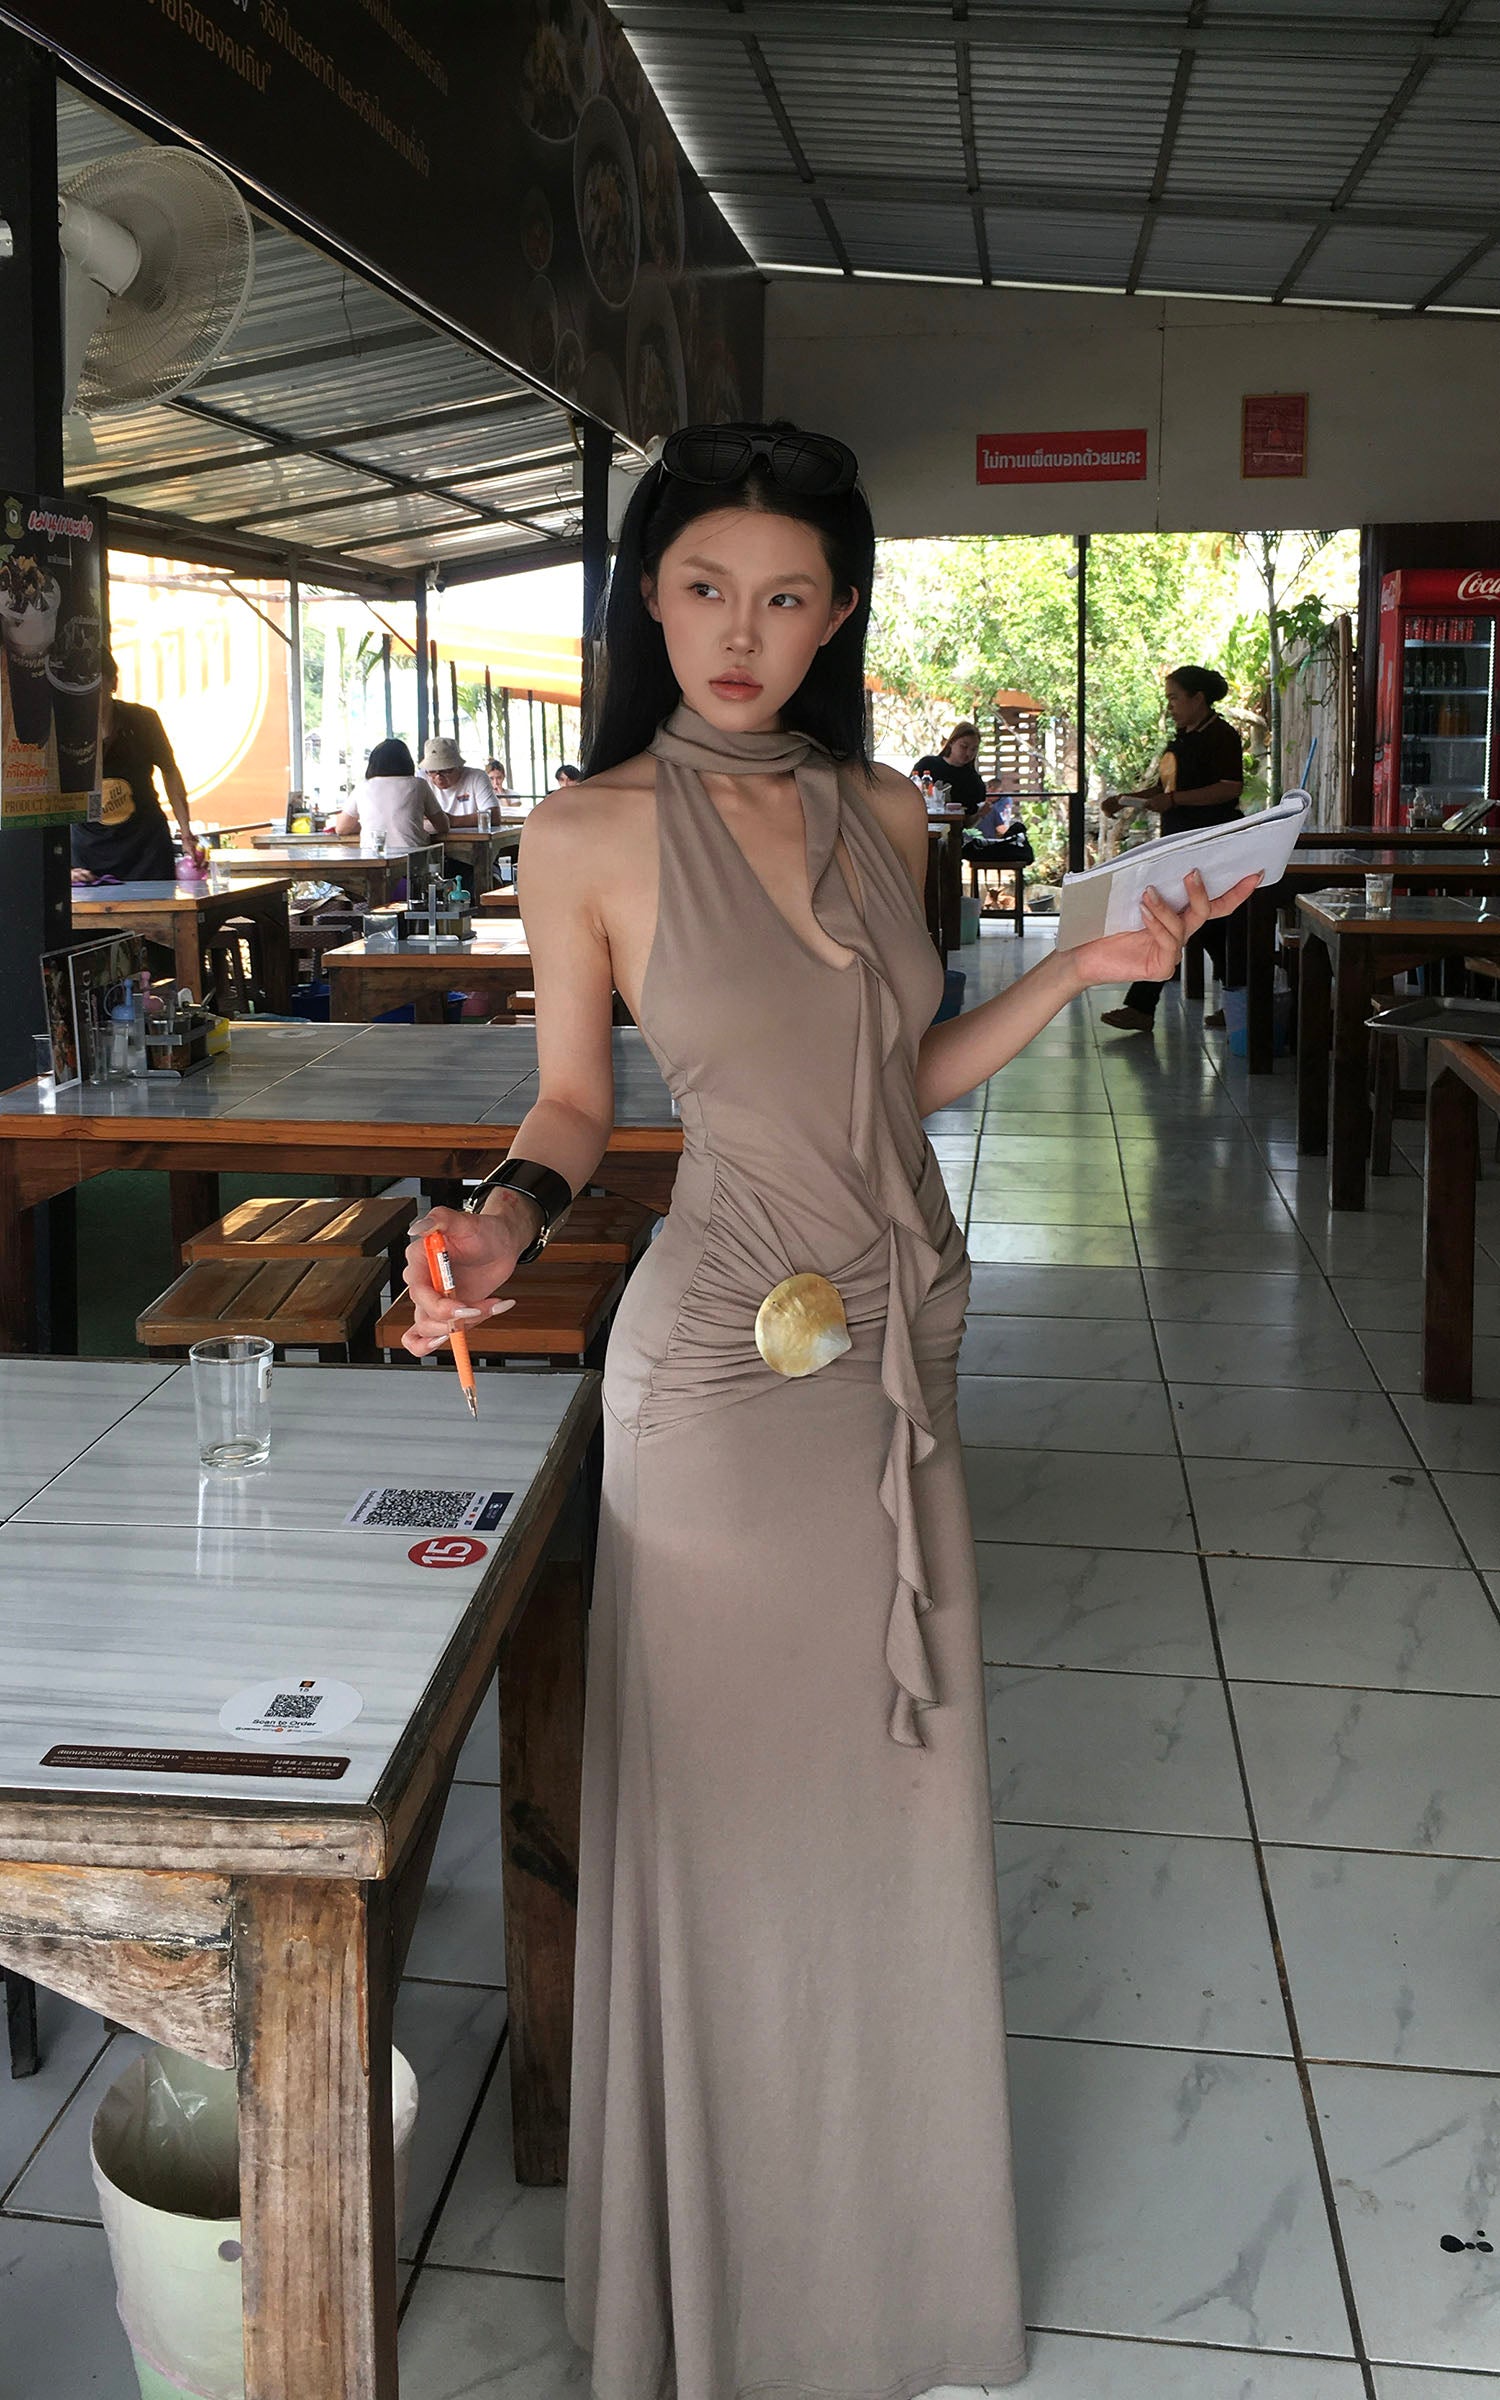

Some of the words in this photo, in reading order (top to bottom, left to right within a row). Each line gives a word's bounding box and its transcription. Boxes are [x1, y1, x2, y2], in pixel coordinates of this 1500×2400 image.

[982, 447, 1141, 470] ไม่ทานเผ็ดบอกด้วยนะคะ
[28, 510, 93, 542] เมนูแนะนำ
[5, 799, 43, 813] PRODUCT
[421, 1541, 472, 1564] 15
